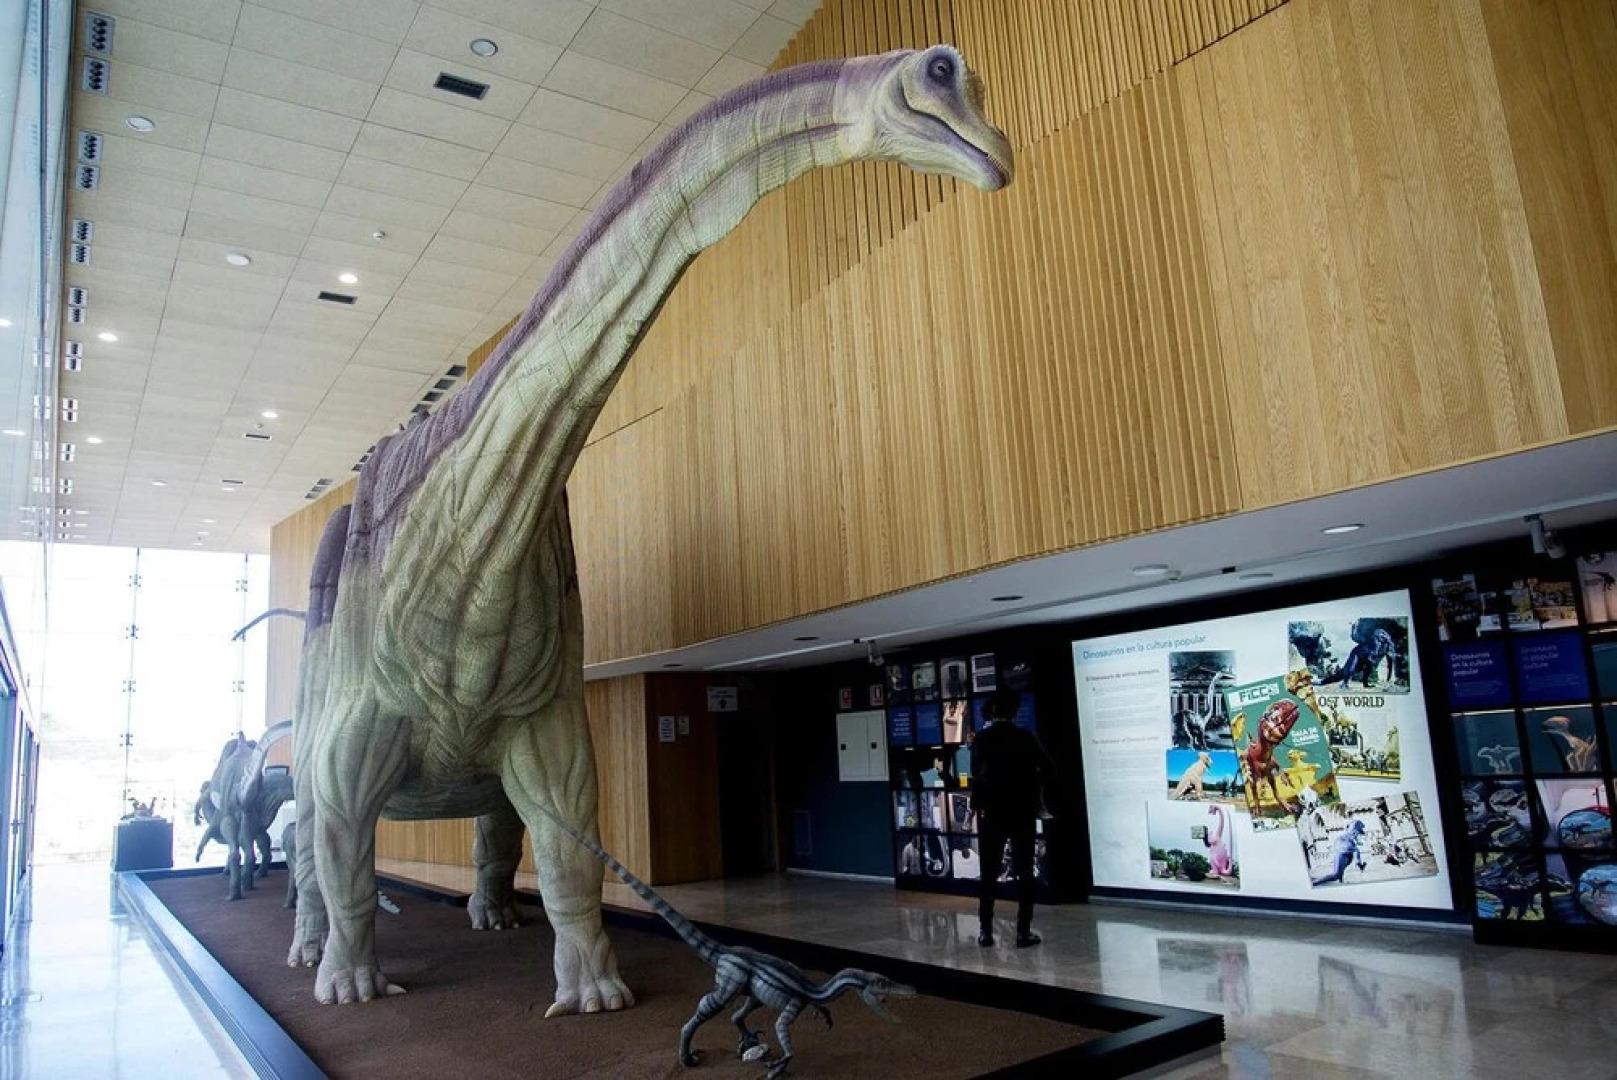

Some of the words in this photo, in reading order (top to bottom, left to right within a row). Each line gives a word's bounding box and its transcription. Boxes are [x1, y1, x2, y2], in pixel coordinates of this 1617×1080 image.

[1083, 646, 1125, 659] Dinosaurios
[1126, 645, 1136, 653] en
[1137, 643, 1144, 651] la
[1146, 640, 1172, 651] cultura
[1174, 635, 1206, 648] popular
[1470, 659, 1493, 667] cultura
[1319, 697, 1340, 707] OST
[1343, 696, 1385, 708] WORLD
